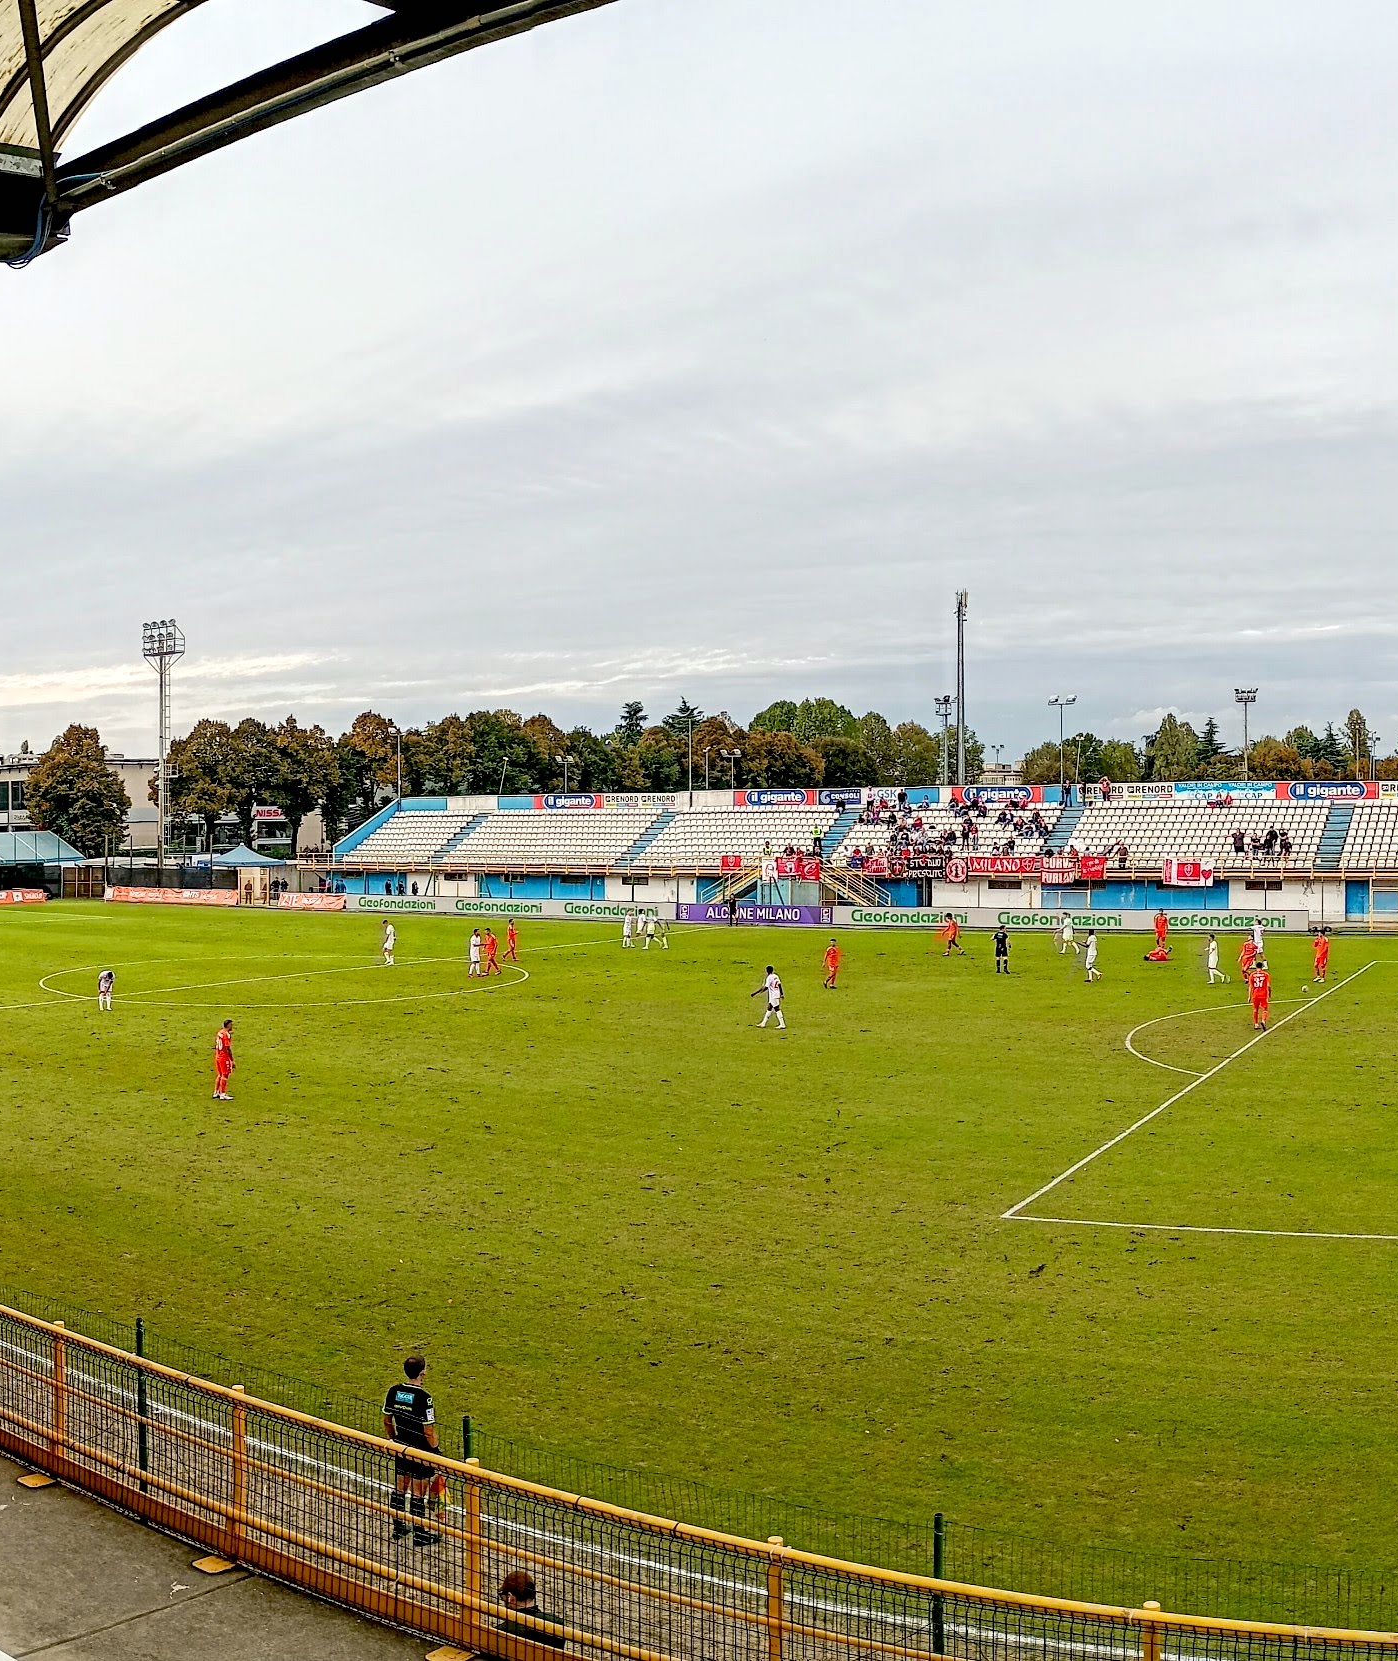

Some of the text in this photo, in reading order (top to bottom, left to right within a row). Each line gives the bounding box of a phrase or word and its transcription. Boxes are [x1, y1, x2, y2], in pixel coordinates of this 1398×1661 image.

[877, 790, 897, 799] GSK
[1086, 786, 1124, 795] RENRD
[1135, 785, 1173, 794] RENORD
[1296, 784, 1360, 798] il gigante
[548, 795, 592, 807] il gigante
[751, 791, 802, 803] il gigante
[831, 792, 860, 800] CONSOLI
[972, 858, 1020, 872] MILANO
[358, 896, 436, 910] Geofondazioni
[455, 899, 543, 913] Geofondazioni
[756, 908, 801, 921] MILANO
[997, 911, 1122, 927] Geofonazioni
[1254, 977, 1265, 988] 37
